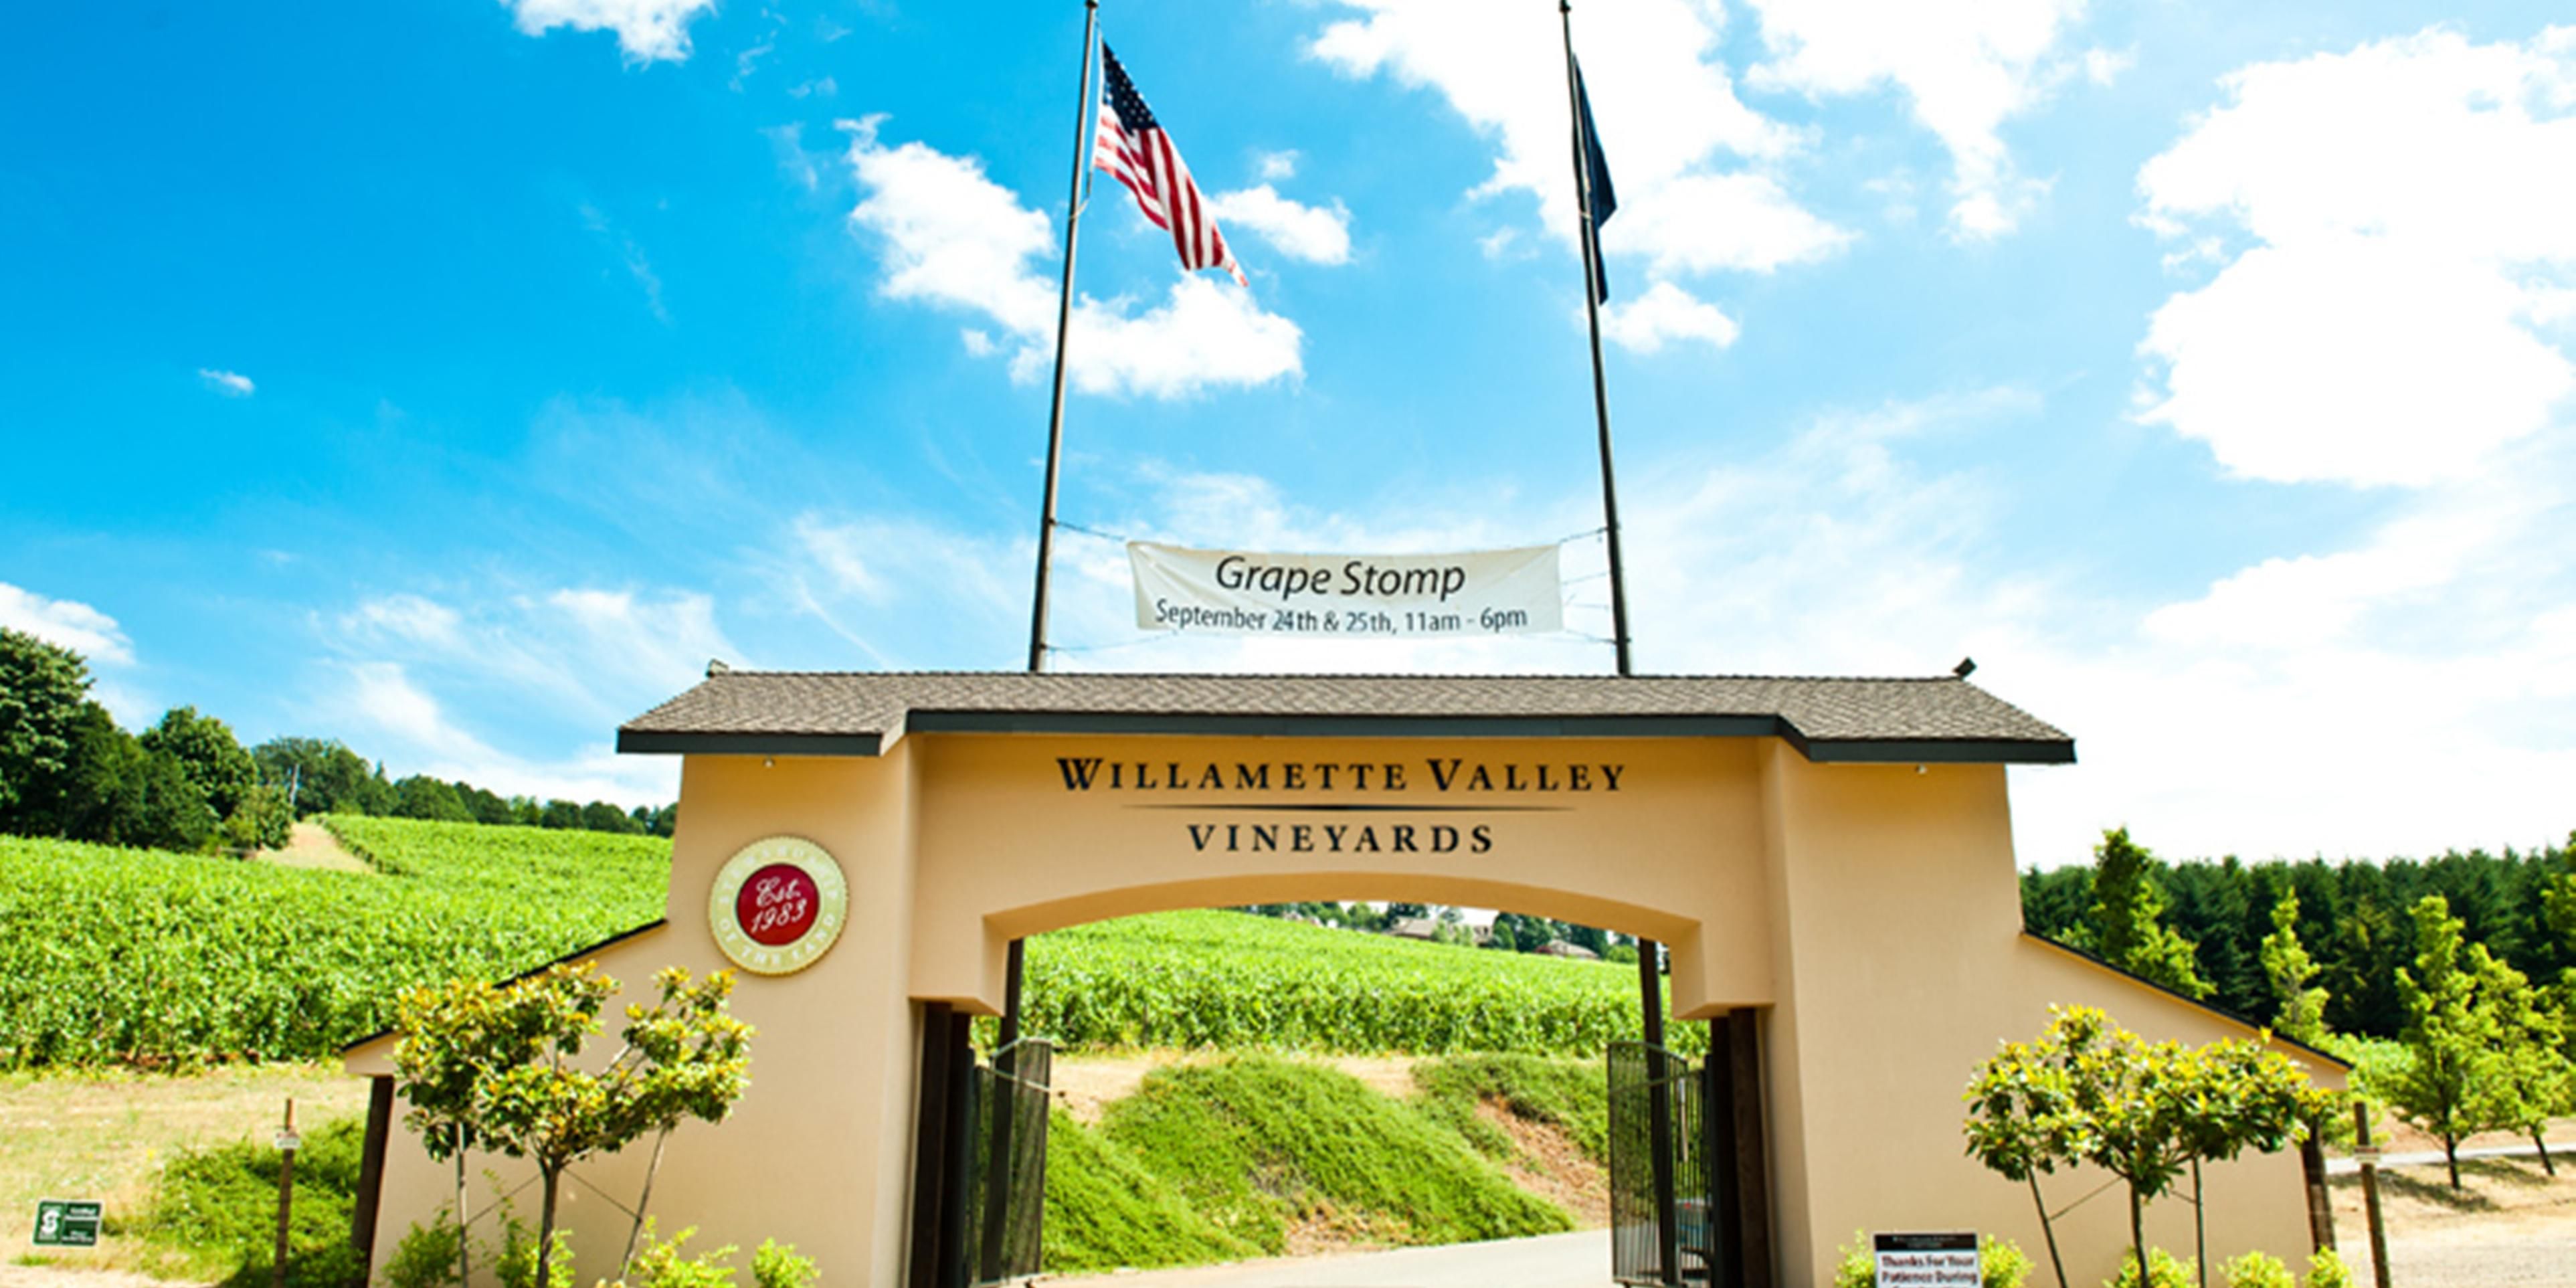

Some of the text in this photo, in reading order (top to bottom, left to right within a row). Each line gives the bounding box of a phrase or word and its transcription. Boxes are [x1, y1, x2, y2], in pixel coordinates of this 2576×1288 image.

[1215, 555, 1465, 601] Grape Stomp
[1156, 599, 1267, 630] September
[1271, 610, 1317, 630] 24th
[1322, 611, 1340, 631] &
[1345, 612, 1398, 634] 25th,
[1404, 612, 1462, 631] 11am
[1480, 608, 1528, 631] 6pm
[1056, 757, 1625, 792] WILLAMETTE VALLEY
[1187, 824, 1493, 853] VINEYARDS
[751, 898, 807, 933] 1983
[741, 945, 781, 965] THE
[792, 913, 836, 961] LAND
[1881, 1255, 1974, 1267] Thanks For Your
[1881, 1270, 1978, 1284] Patience During
